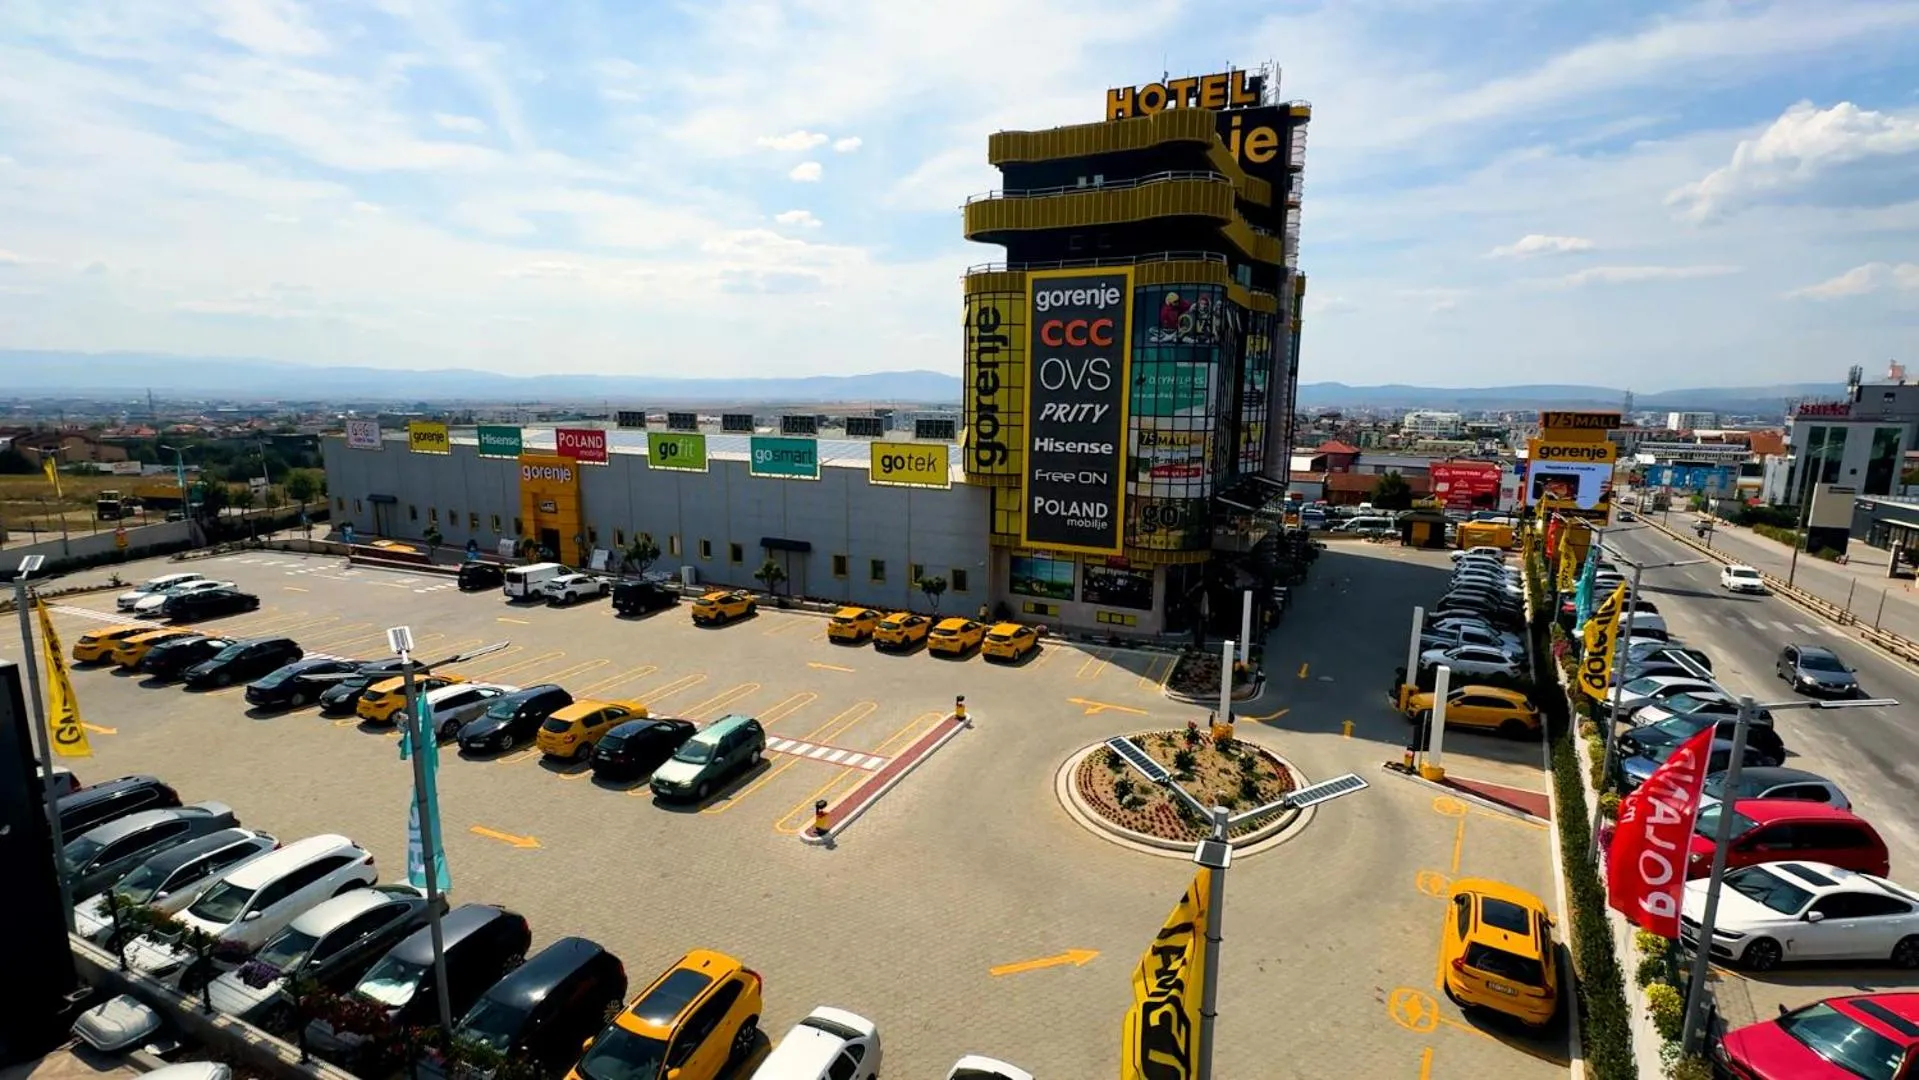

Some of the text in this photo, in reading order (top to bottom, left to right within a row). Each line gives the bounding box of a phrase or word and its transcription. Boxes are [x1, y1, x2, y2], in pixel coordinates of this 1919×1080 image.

[1106, 70, 1257, 120] HOTEL
[1036, 283, 1120, 312] gorenje
[1040, 318, 1113, 346] CCC
[1040, 357, 1111, 390] OVS
[971, 305, 1008, 467] gorenje
[1039, 402, 1110, 423] PRITY
[1575, 416, 1617, 427] MALL
[413, 432, 444, 444] gorenje
[481, 433, 519, 446] Hisense
[559, 432, 604, 449] POLAND
[1034, 437, 1113, 455] Hisense
[1538, 445, 1607, 460] gorenje
[522, 464, 572, 483] gorenje
[1034, 496, 1108, 519] POLAND
[1066, 517, 1107, 530] mobilje
